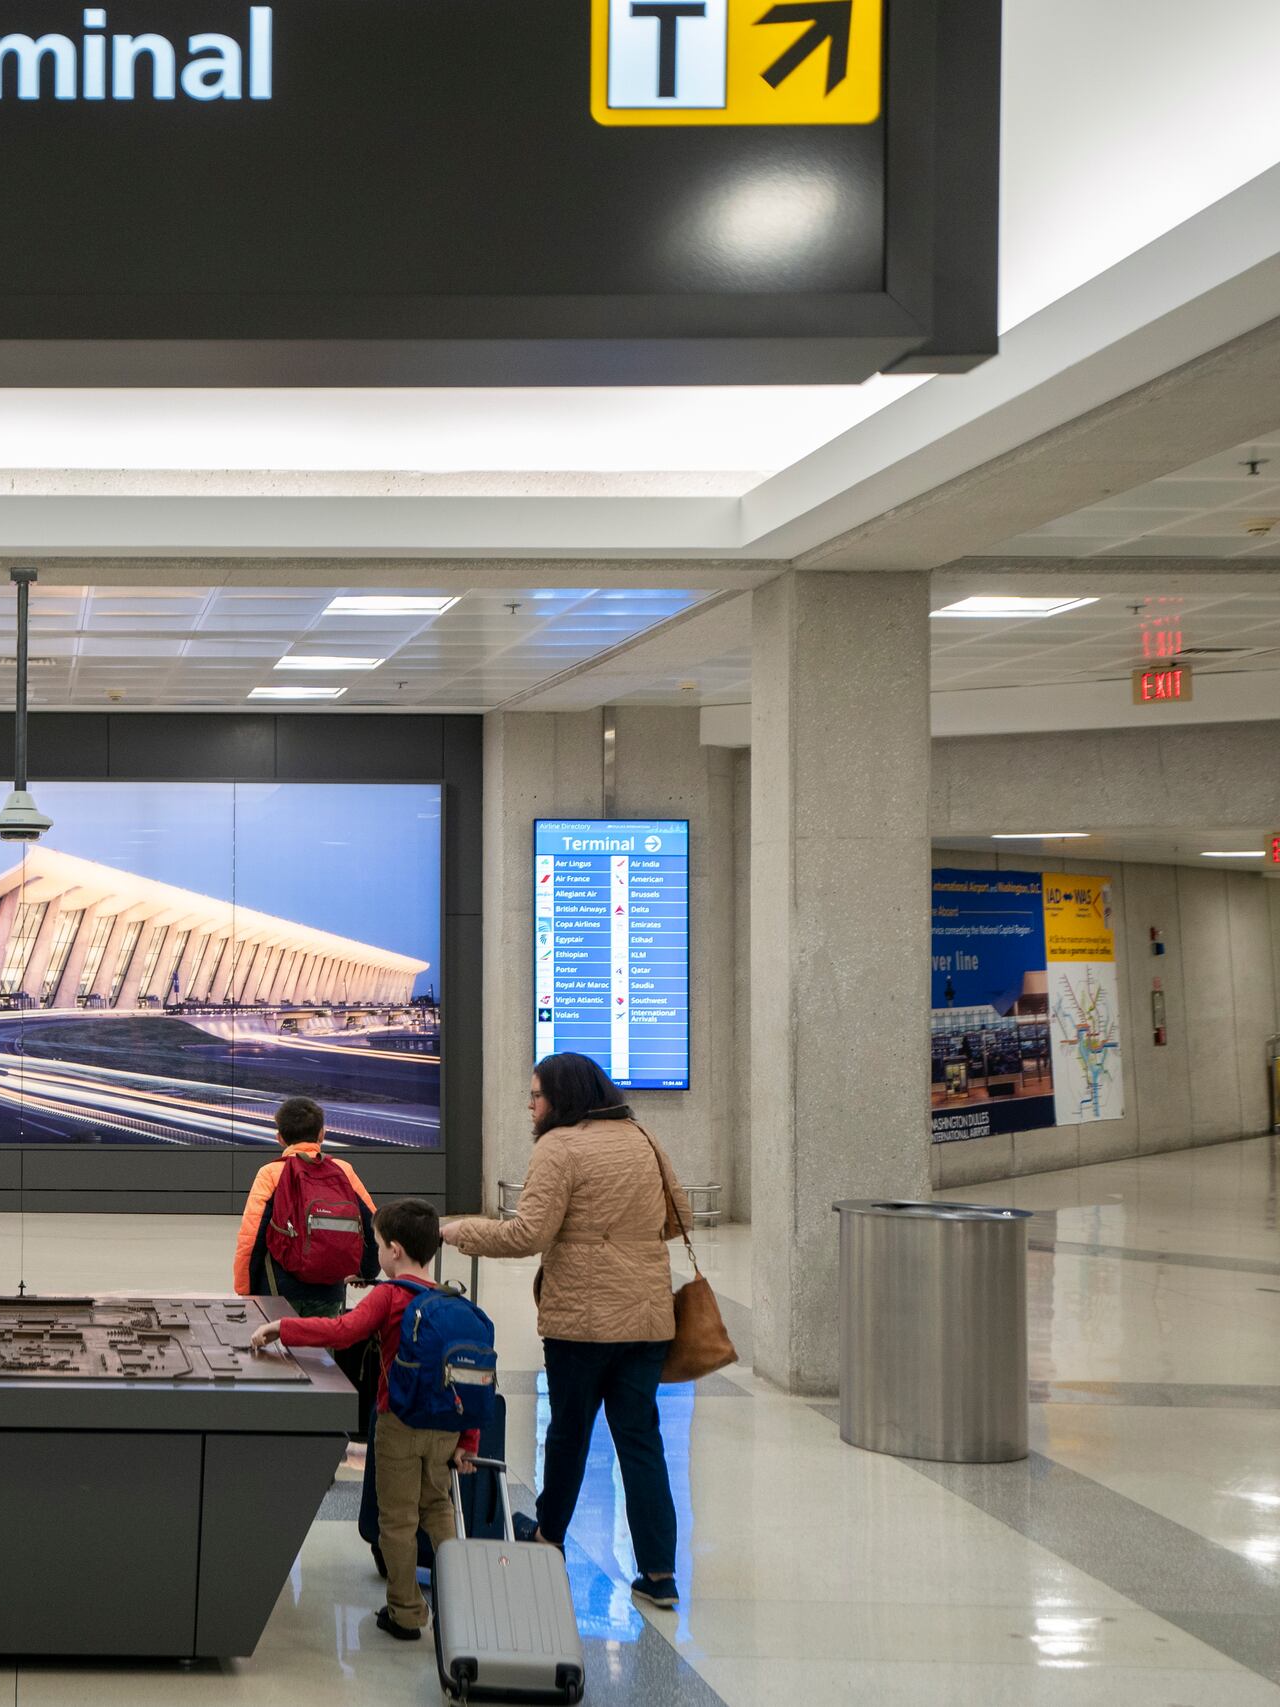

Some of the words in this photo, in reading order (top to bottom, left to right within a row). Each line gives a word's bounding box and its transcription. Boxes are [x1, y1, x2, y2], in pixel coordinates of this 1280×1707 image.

[629, 2, 706, 98] T
[1141, 669, 1183, 700] EXIT
[562, 823, 591, 831] Directory
[562, 836, 635, 851] Terminal
[555, 860, 569, 868] Aer
[570, 860, 592, 869] Lingus
[631, 860, 642, 868] Air
[642, 860, 660, 868] India
[555, 890, 586, 899] Allegiant
[1046, 888, 1062, 904] IAD
[1073, 888, 1092, 905] WAS
[555, 905, 579, 913] British
[580, 905, 607, 914] Airways
[555, 921, 573, 929] Copa
[631, 921, 661, 929] Emirates
[555, 936, 584, 945] Egyptair
[631, 936, 653, 944] Etihad
[555, 951, 588, 959] Ethiopian
[956, 950, 978, 971] line
[555, 981, 575, 990] Royal
[555, 997, 577, 1005] Virgin
[631, 1015, 658, 1023] Arrivals
